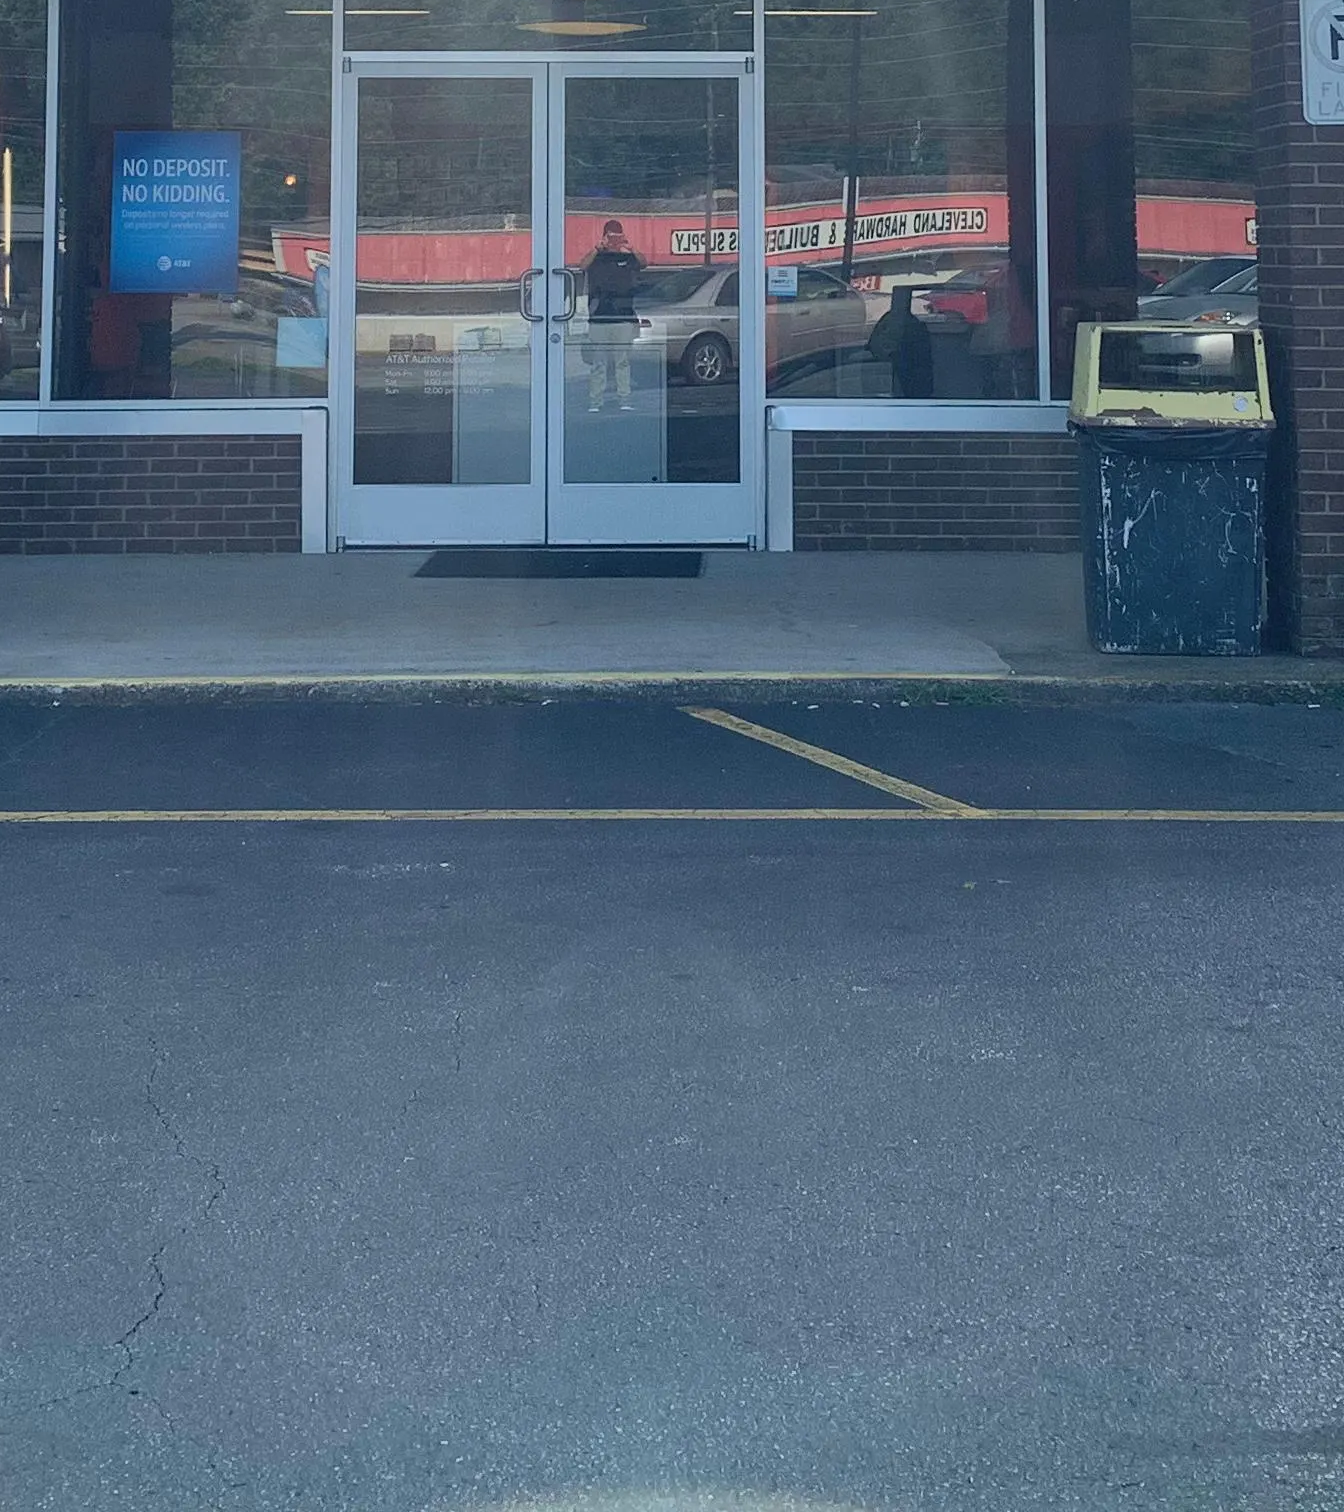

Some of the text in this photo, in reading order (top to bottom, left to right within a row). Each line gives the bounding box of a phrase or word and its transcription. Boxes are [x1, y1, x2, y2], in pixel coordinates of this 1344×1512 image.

[122, 159, 230, 178] NO DEPOSIT.
[122, 184, 230, 203] NO KIDDING.
